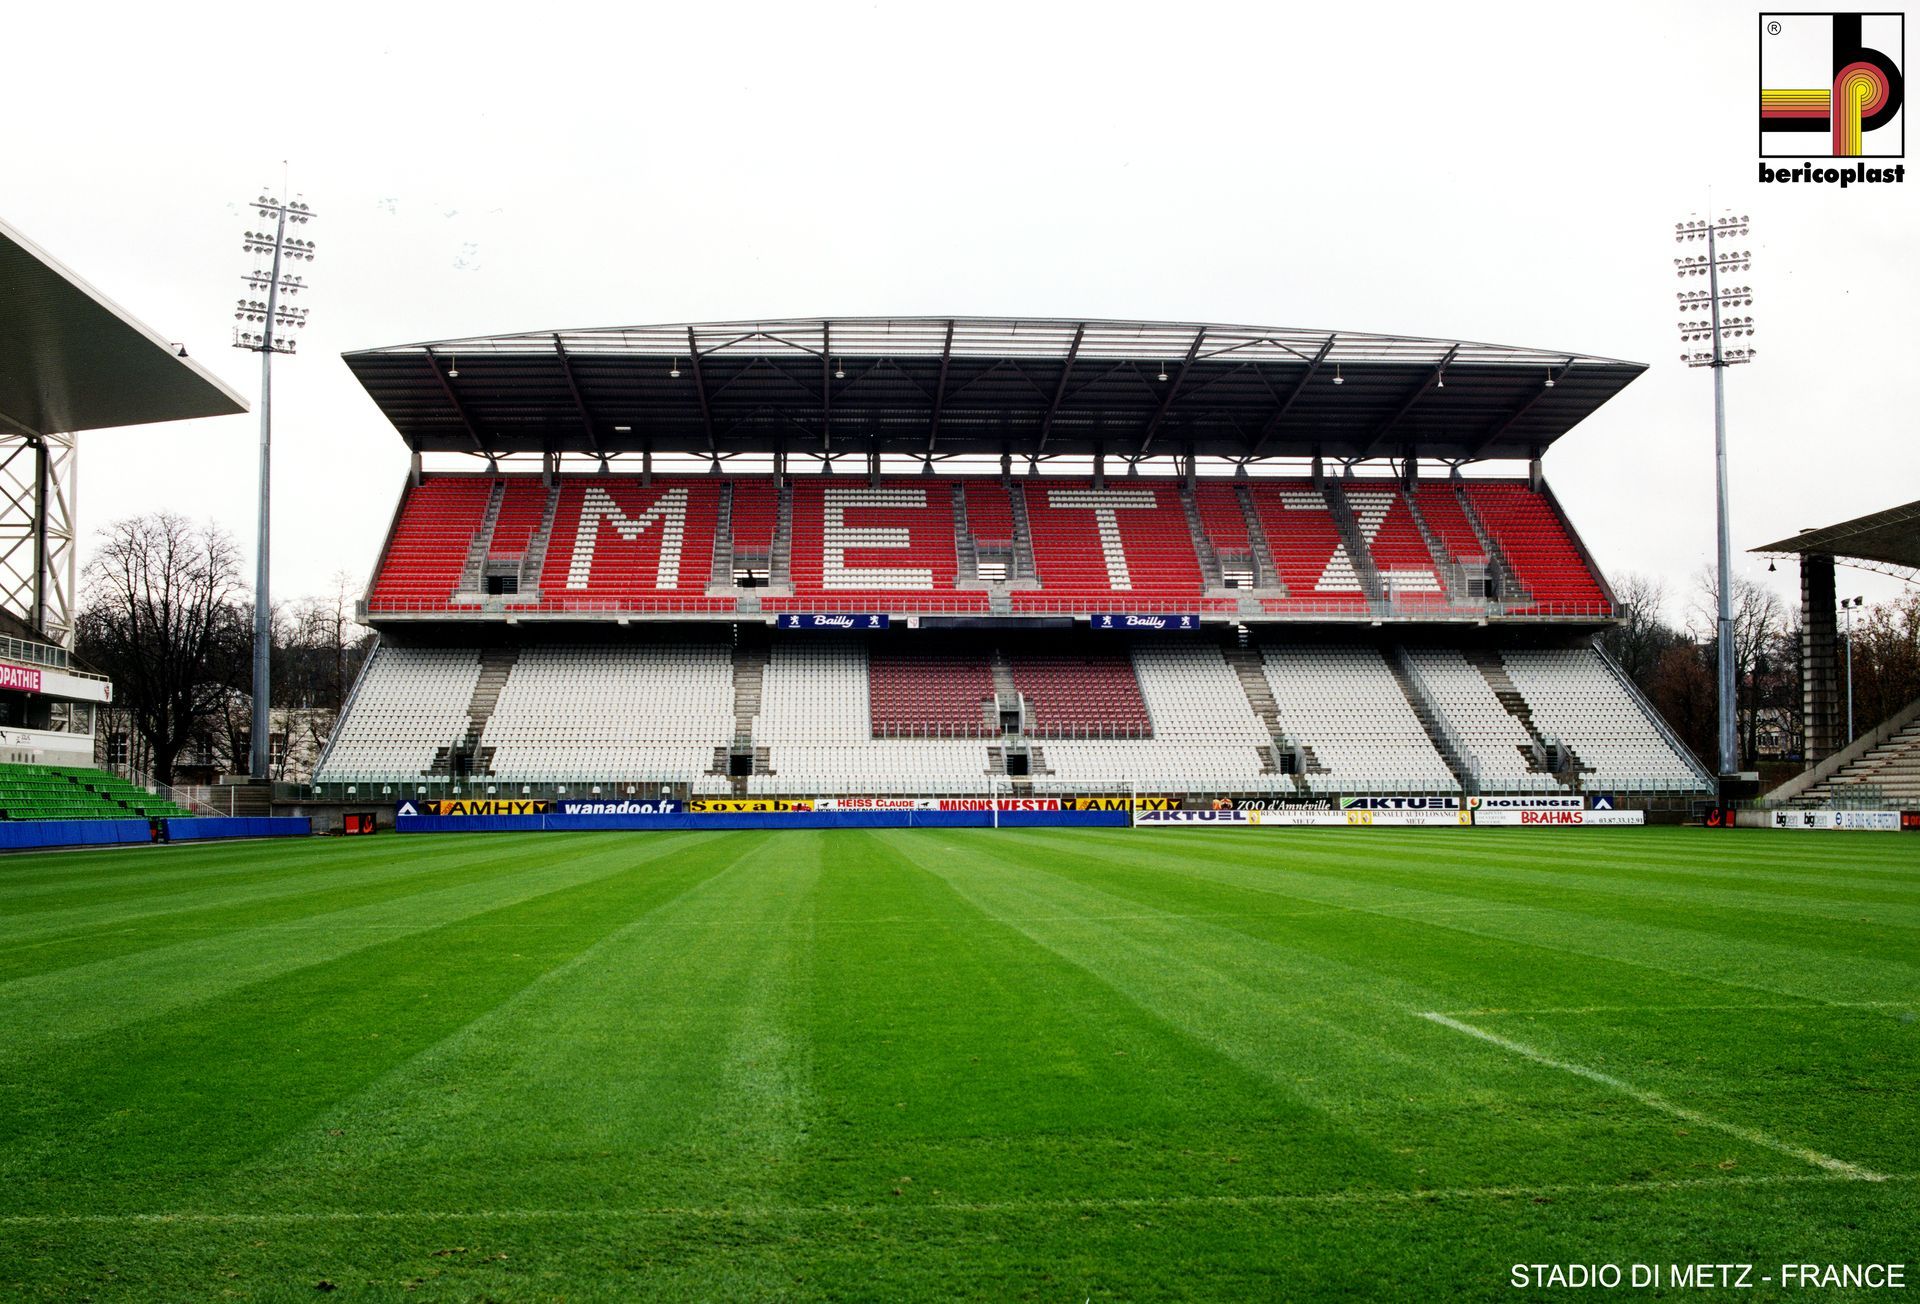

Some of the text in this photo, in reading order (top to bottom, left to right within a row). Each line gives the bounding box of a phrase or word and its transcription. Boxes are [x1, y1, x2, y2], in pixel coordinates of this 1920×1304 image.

[813, 615, 854, 628] Bailly
[1125, 615, 1166, 629] Bailly
[447, 801, 531, 815] AMHY
[565, 800, 675, 814] wanadoo.fr
[838, 799, 872, 807] HEISS
[939, 800, 1059, 811] MAISONS VESTA
[1085, 799, 1166, 811] AMHY
[1237, 800, 1331, 811] ZOO d'Amnéville
[1345, 799, 1459, 809] AKTUEL
[1138, 811, 1247, 821] AKTUEL
[1521, 811, 1583, 824] BRAHMS
